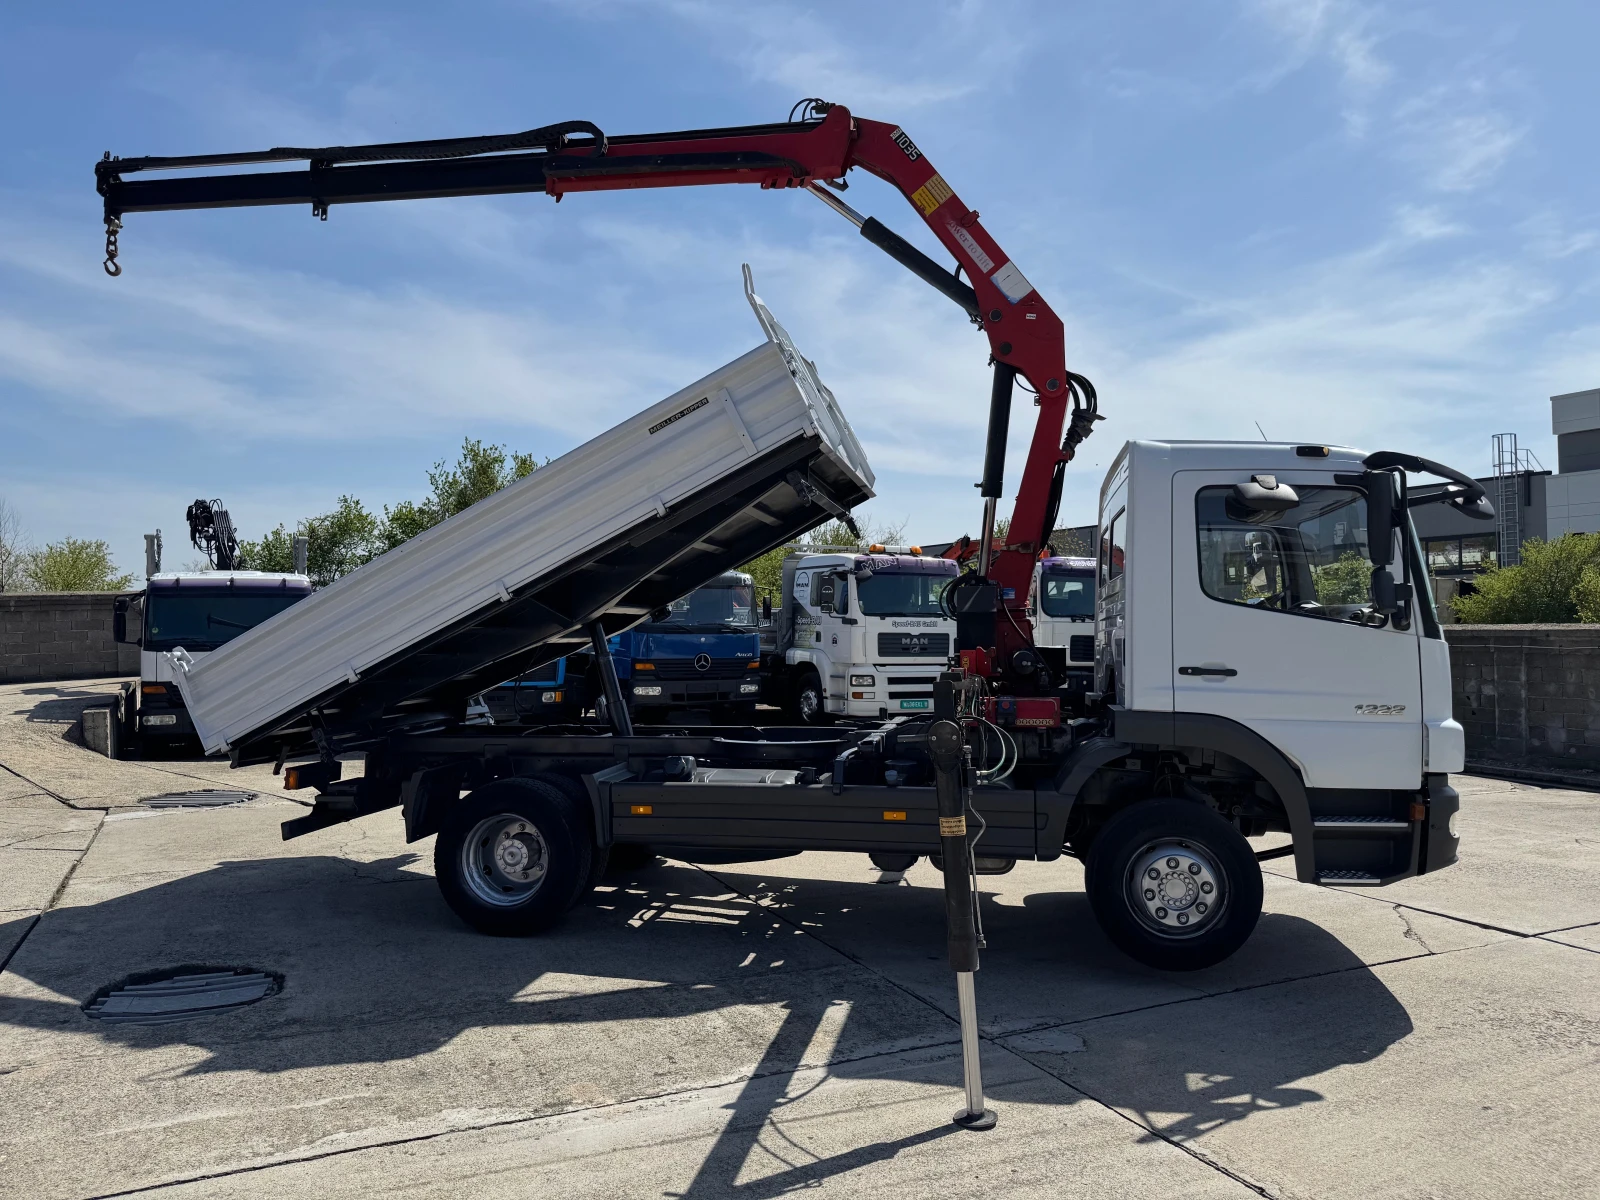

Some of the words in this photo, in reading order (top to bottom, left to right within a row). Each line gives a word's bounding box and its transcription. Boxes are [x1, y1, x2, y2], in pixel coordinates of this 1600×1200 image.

[896, 134, 921, 161] 1035
[946, 219, 970, 244] ower
[967, 243, 977, 254] to
[649, 398, 708, 434] MEILLER-KIPPER
[860, 557, 898, 571] MAN
[901, 637, 928, 645] MAN
[1354, 704, 1406, 716] 1222
